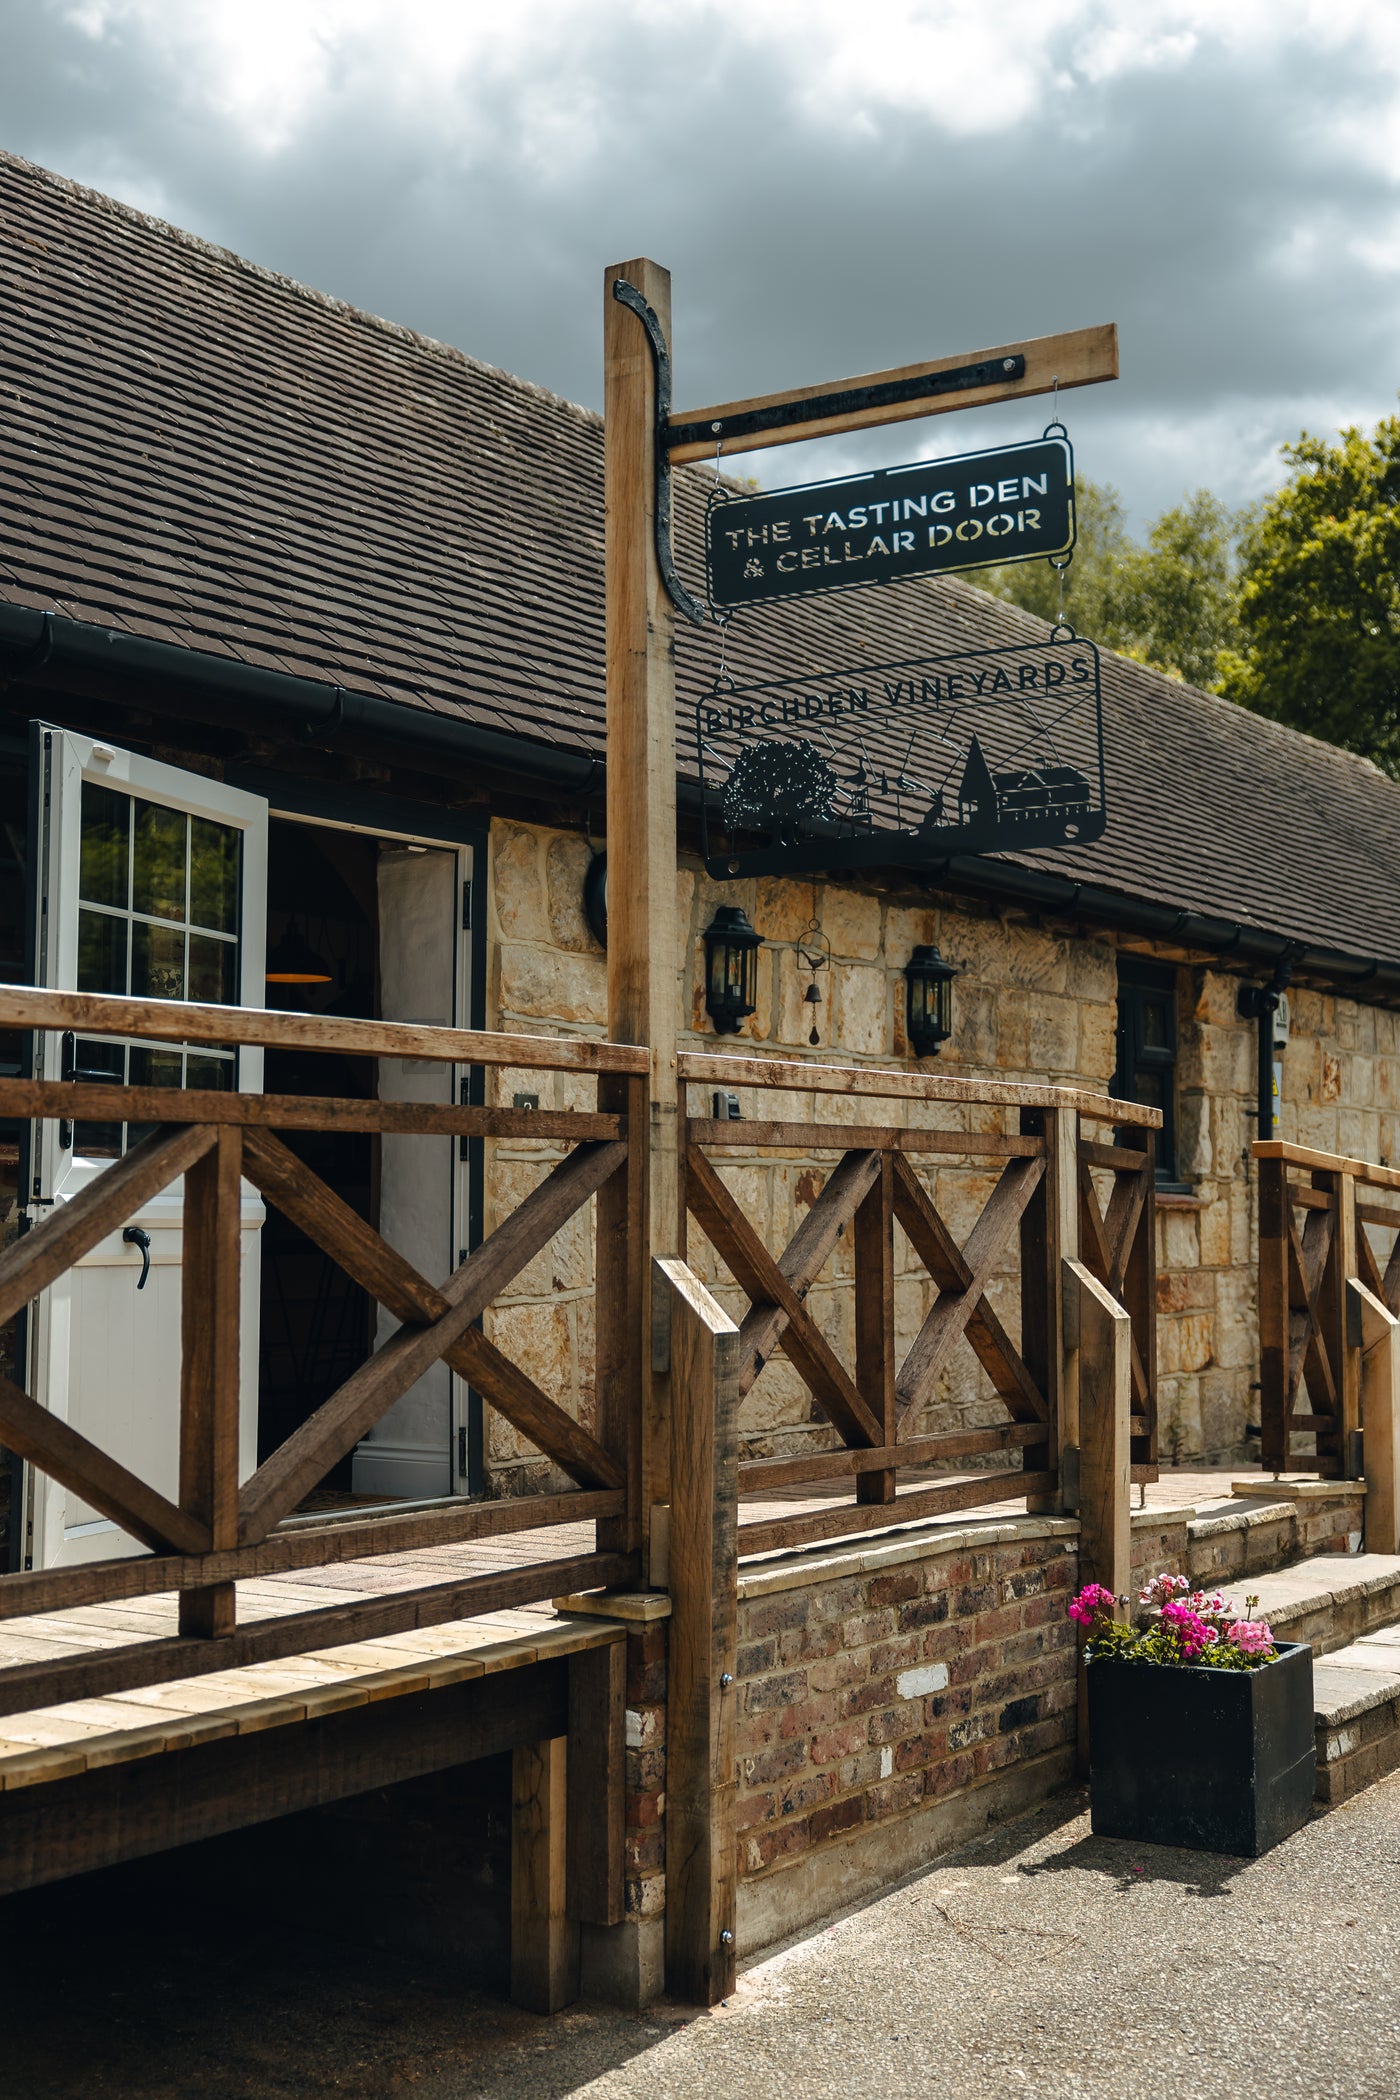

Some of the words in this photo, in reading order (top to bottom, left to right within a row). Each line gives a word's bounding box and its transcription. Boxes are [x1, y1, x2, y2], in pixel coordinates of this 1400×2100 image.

[725, 519, 792, 551] THE
[803, 490, 956, 536] TASTING
[969, 473, 1048, 508] DEN
[743, 557, 765, 580] &
[776, 531, 916, 574] CELLAR
[928, 508, 1042, 548] DOOR
[706, 687, 868, 732] BIRCHDEN
[884, 657, 1090, 706] VINEYARDS
